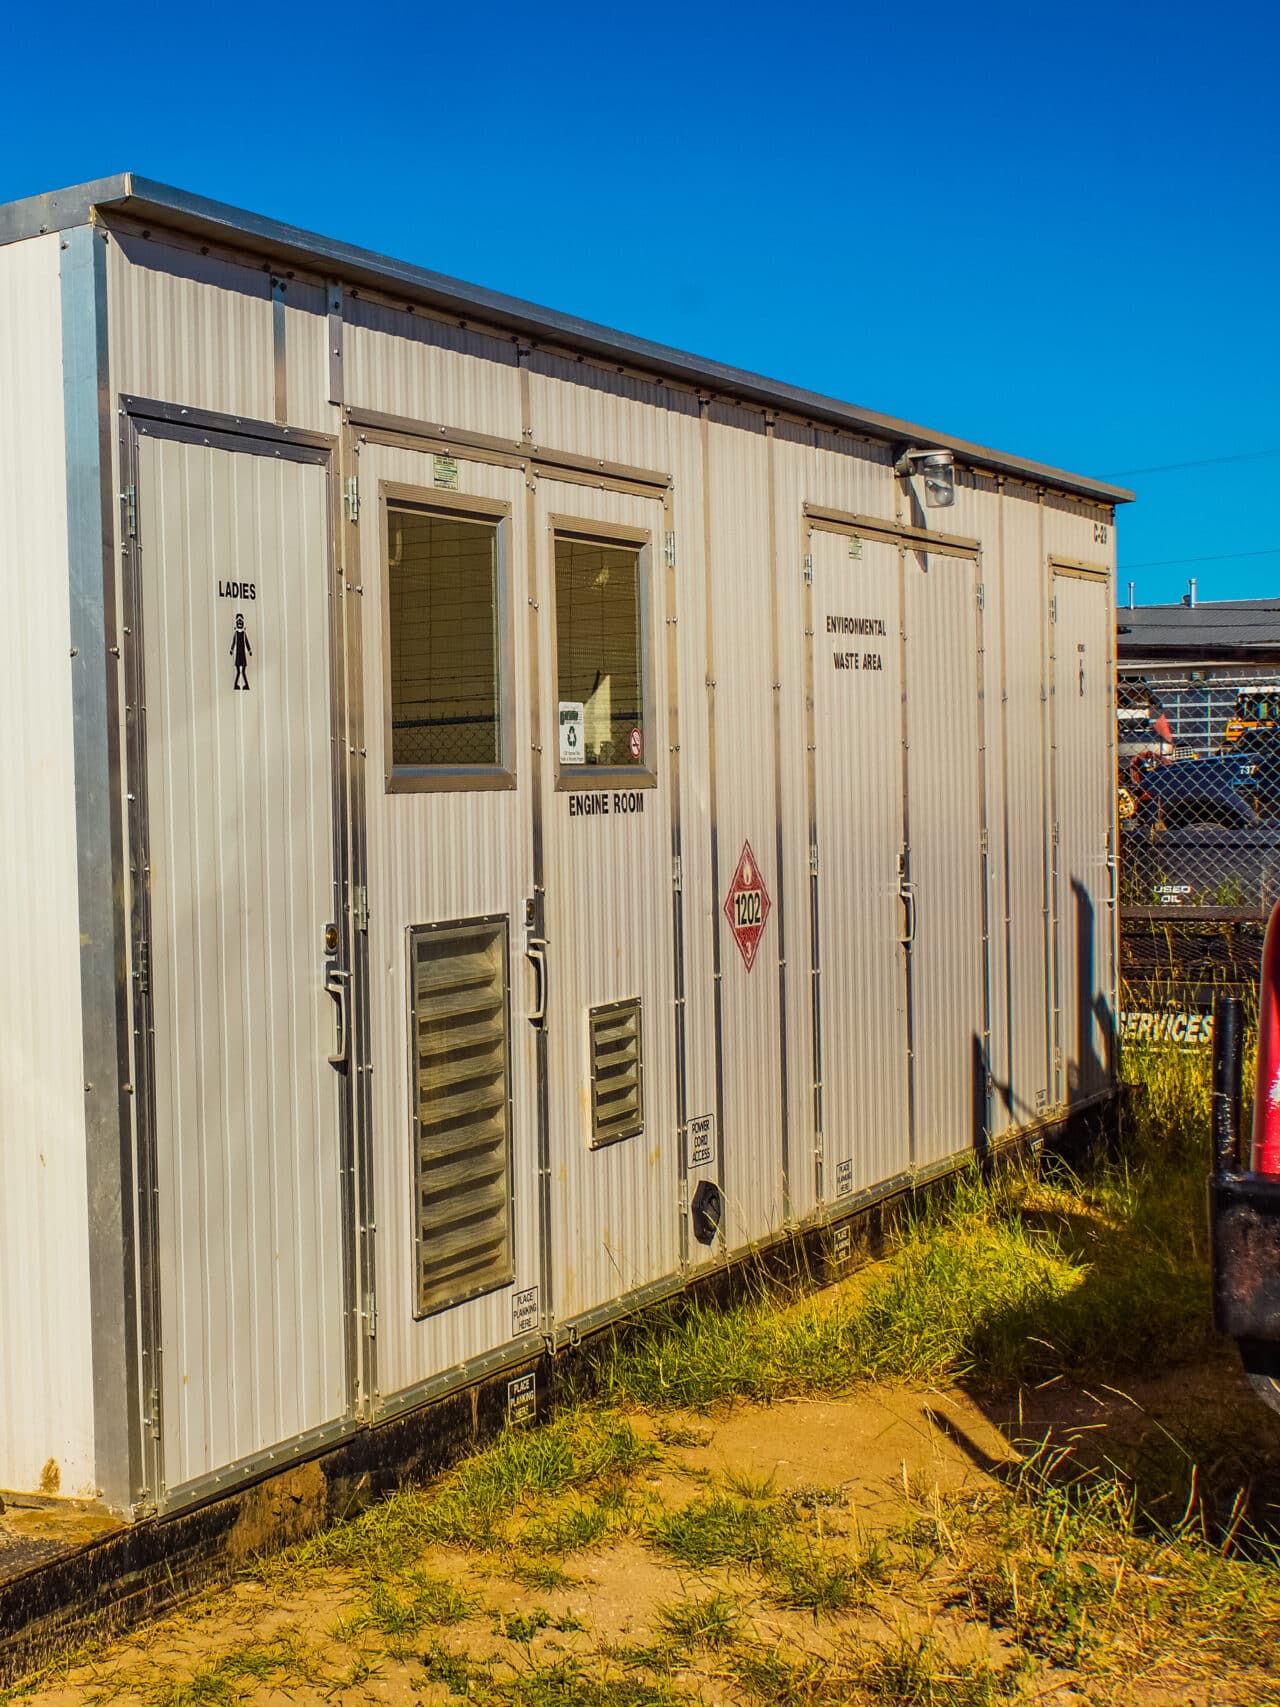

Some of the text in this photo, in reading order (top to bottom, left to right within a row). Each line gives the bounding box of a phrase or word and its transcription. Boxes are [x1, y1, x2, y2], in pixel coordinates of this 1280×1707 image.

[218, 580, 256, 600] LADIES
[826, 615, 887, 636] ENVIRONMENTAL
[833, 652, 883, 671] WASTE AREA
[569, 792, 645, 816] ENGINE ROOM
[1153, 885, 1192, 894] USED
[736, 891, 761, 926] 1202
[745, 941, 753, 959] 3
[691, 1119, 710, 1135] POWER
[694, 1134, 708, 1149] CORD
[692, 1147, 711, 1164] ACCESS
[516, 1291, 534, 1306] PLACE
[513, 1302, 537, 1320] PLANKING
[518, 1317, 532, 1330] HERE
